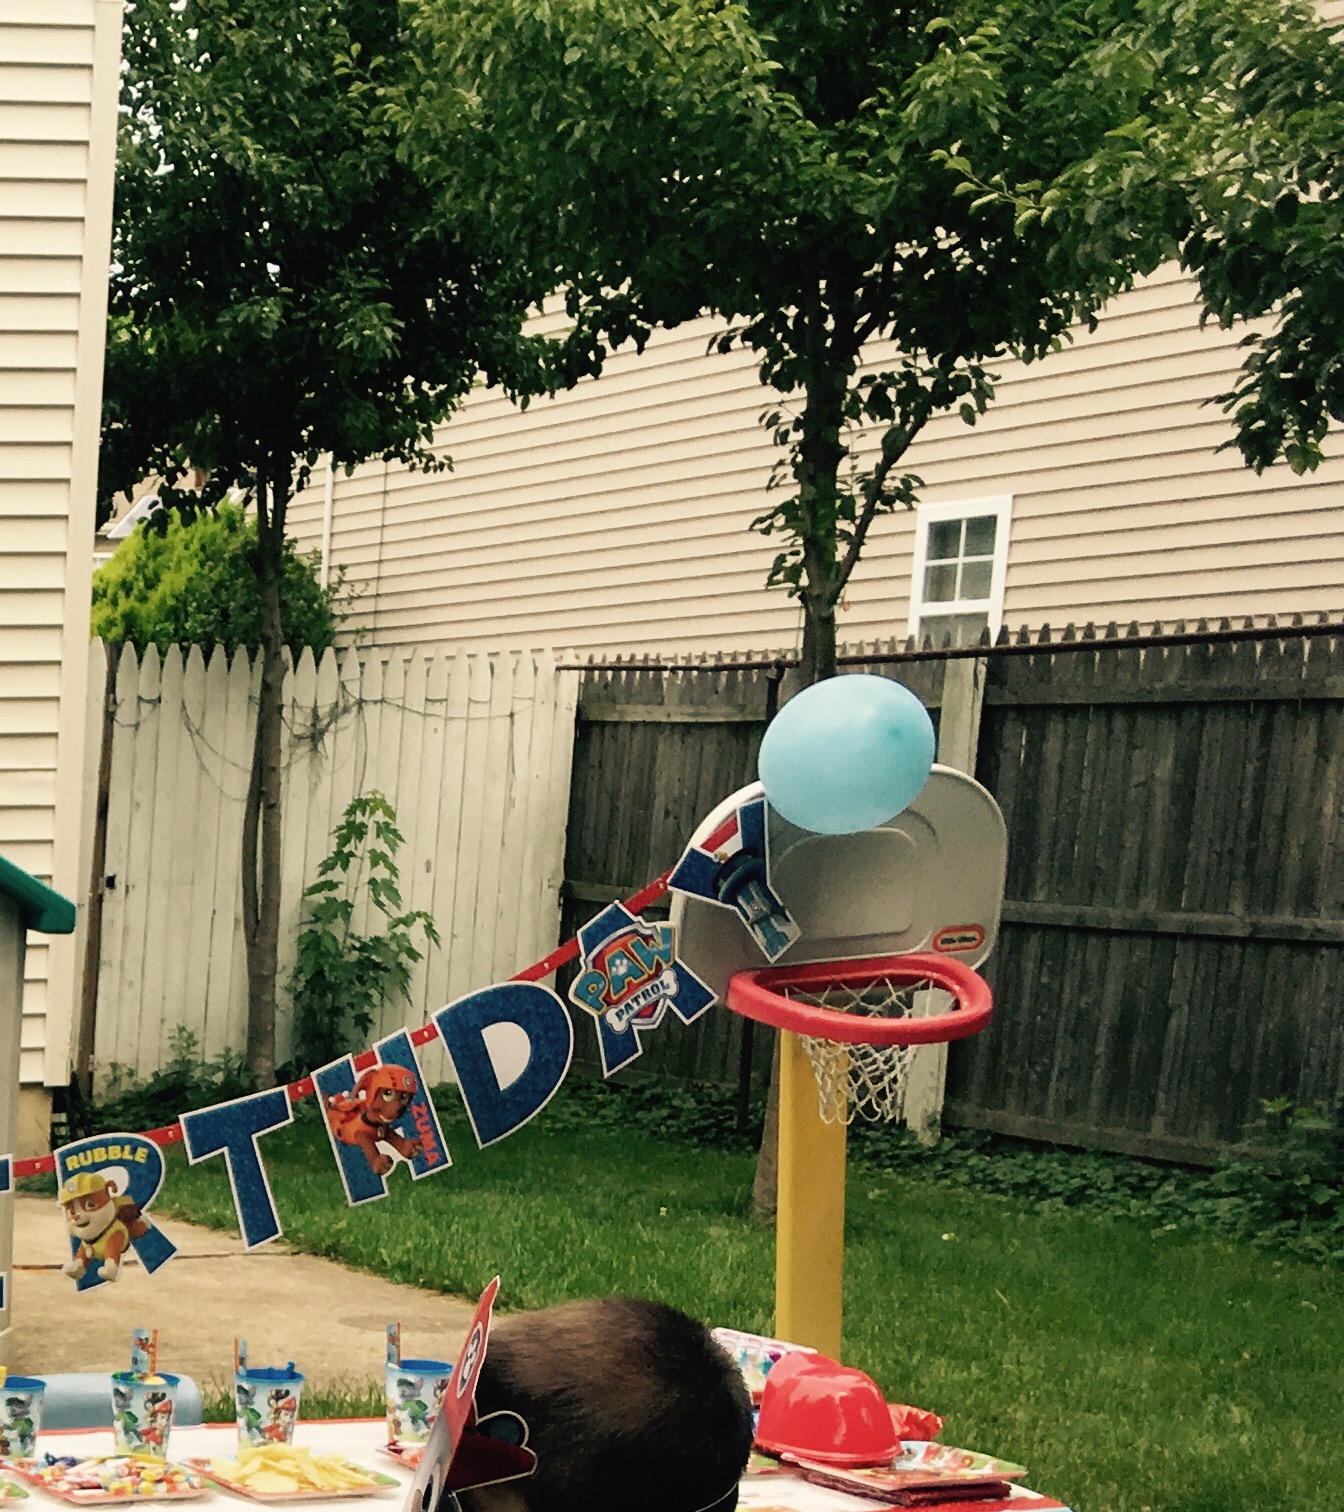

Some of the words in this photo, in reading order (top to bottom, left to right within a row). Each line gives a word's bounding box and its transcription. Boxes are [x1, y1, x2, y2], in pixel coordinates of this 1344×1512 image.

[572, 925, 676, 1015] PAW
[614, 979, 670, 1021] PATROL
[65, 1144, 149, 1171] RUBBLE
[410, 1101, 441, 1167] ZUMA
